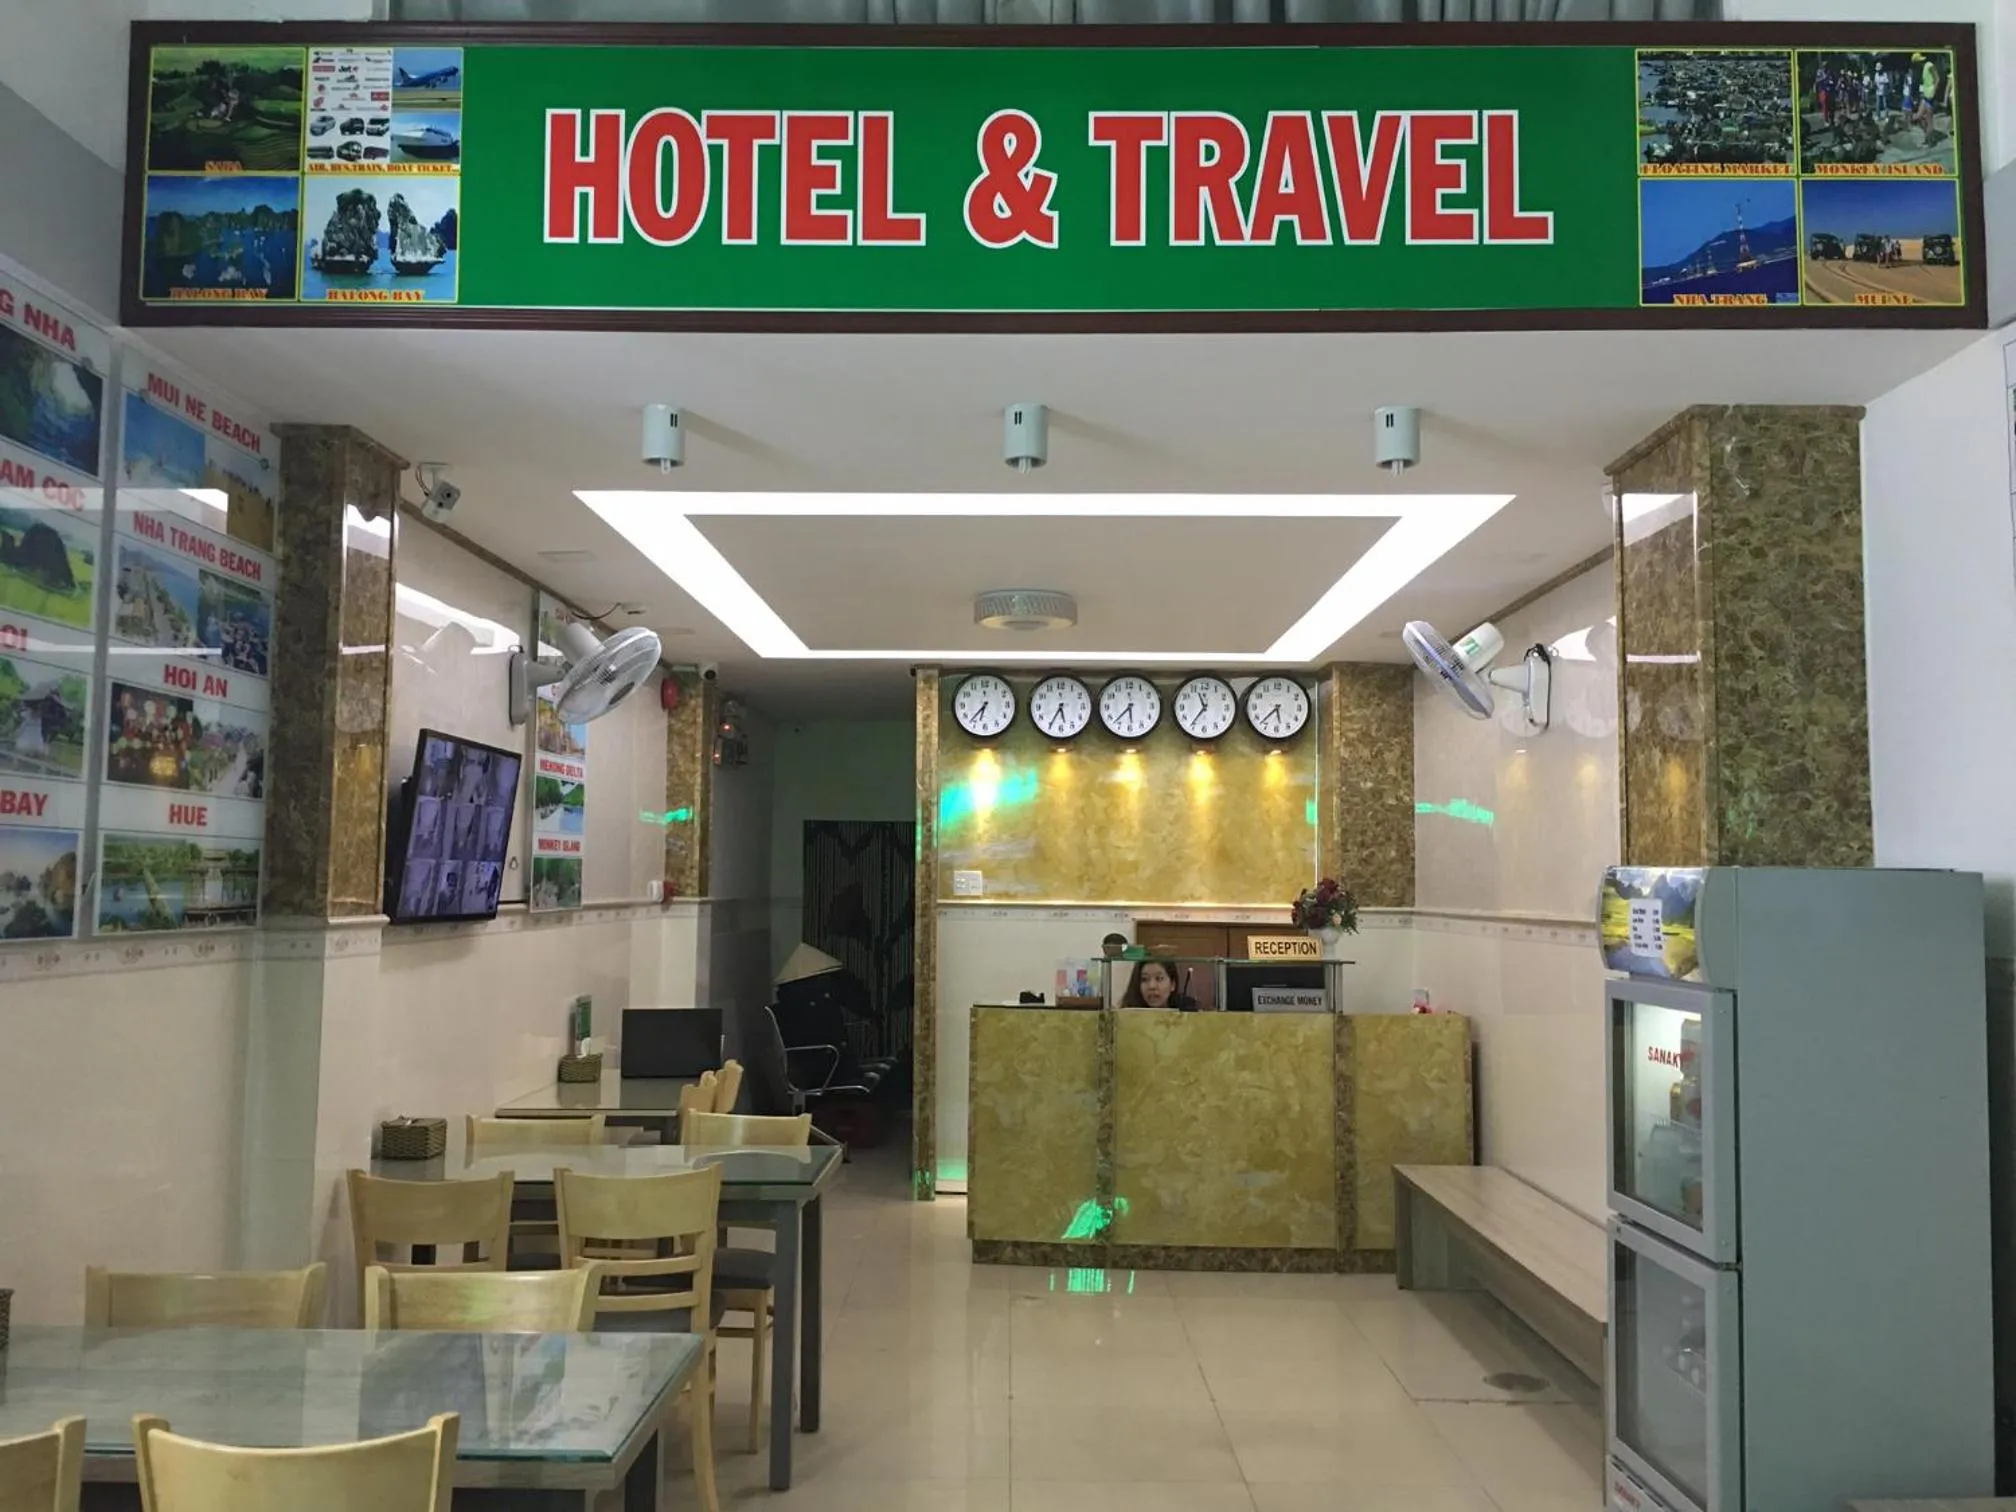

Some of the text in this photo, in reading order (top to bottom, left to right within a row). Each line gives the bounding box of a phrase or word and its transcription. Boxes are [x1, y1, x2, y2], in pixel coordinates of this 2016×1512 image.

[543, 106, 1555, 249] HOTEL & TRAVEL
[1815, 164, 1944, 174] MONKEY ISLAND
[327, 290, 423, 301] HALONG BAY
[1674, 294, 1709, 304] NHA
[1711, 294, 1767, 304] TRANG
[24, 302, 77, 352] NHA
[147, 371, 261, 455] MUI NE BEACH
[0, 457, 35, 493] AM
[133, 509, 262, 582] NHA TRANG BEACH
[163, 663, 229, 699] HOI AN
[0, 789, 49, 817] BAY
[168, 803, 208, 827] HUE
[1254, 941, 1317, 955] RECEPTION
[1257, 995, 1322, 1006] EXCHANGE MONEY
